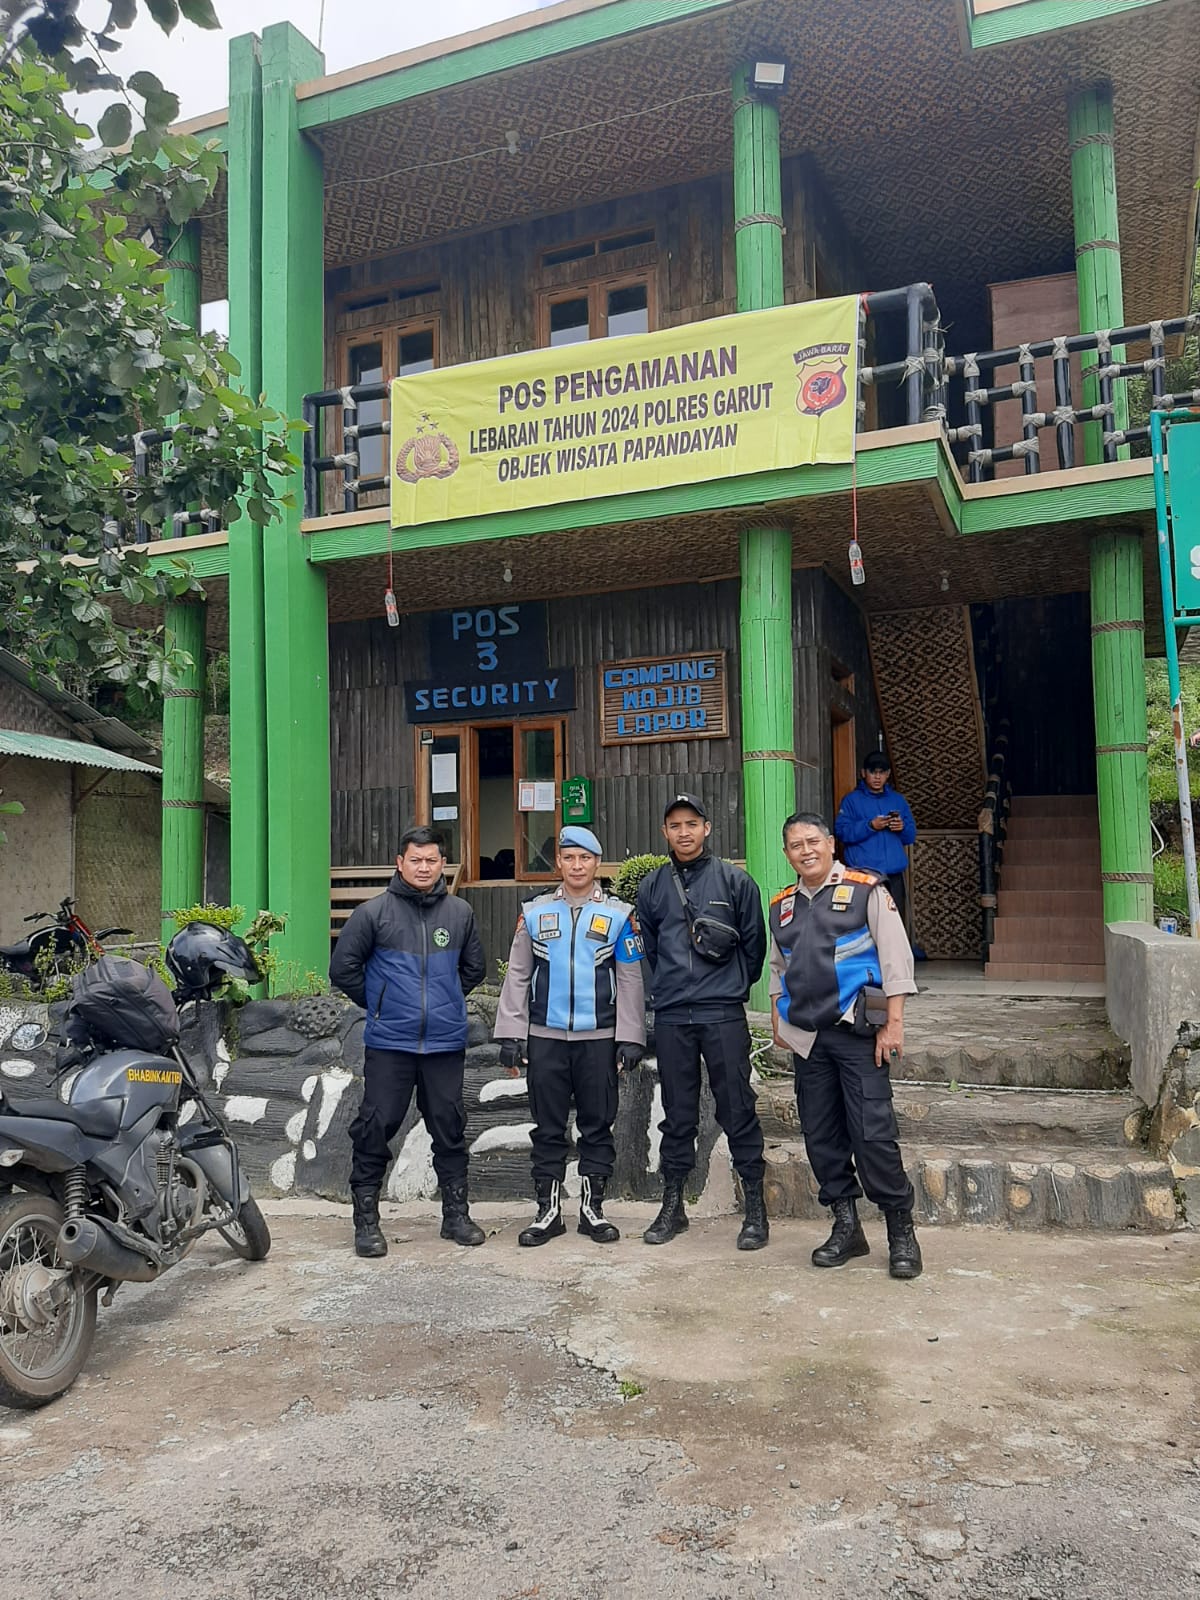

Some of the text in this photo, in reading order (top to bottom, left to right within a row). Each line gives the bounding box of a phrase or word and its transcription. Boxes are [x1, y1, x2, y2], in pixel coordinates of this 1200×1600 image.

[798, 347, 820, 361] JAWA
[499, 345, 737, 413] POS PENGAMANAN
[470, 382, 774, 454] LEBARAN TAHUN 2024 POLRES GARUT
[498, 423, 738, 482] OBJEK WISATA PAPANDAYAN
[452, 606, 520, 640] POS
[476, 641, 498, 671] 3
[604, 658, 716, 688] CAMPING
[415, 678, 560, 711] SECURITY
[623, 685, 701, 711] WAJIB
[617, 707, 707, 735] LAPOR
